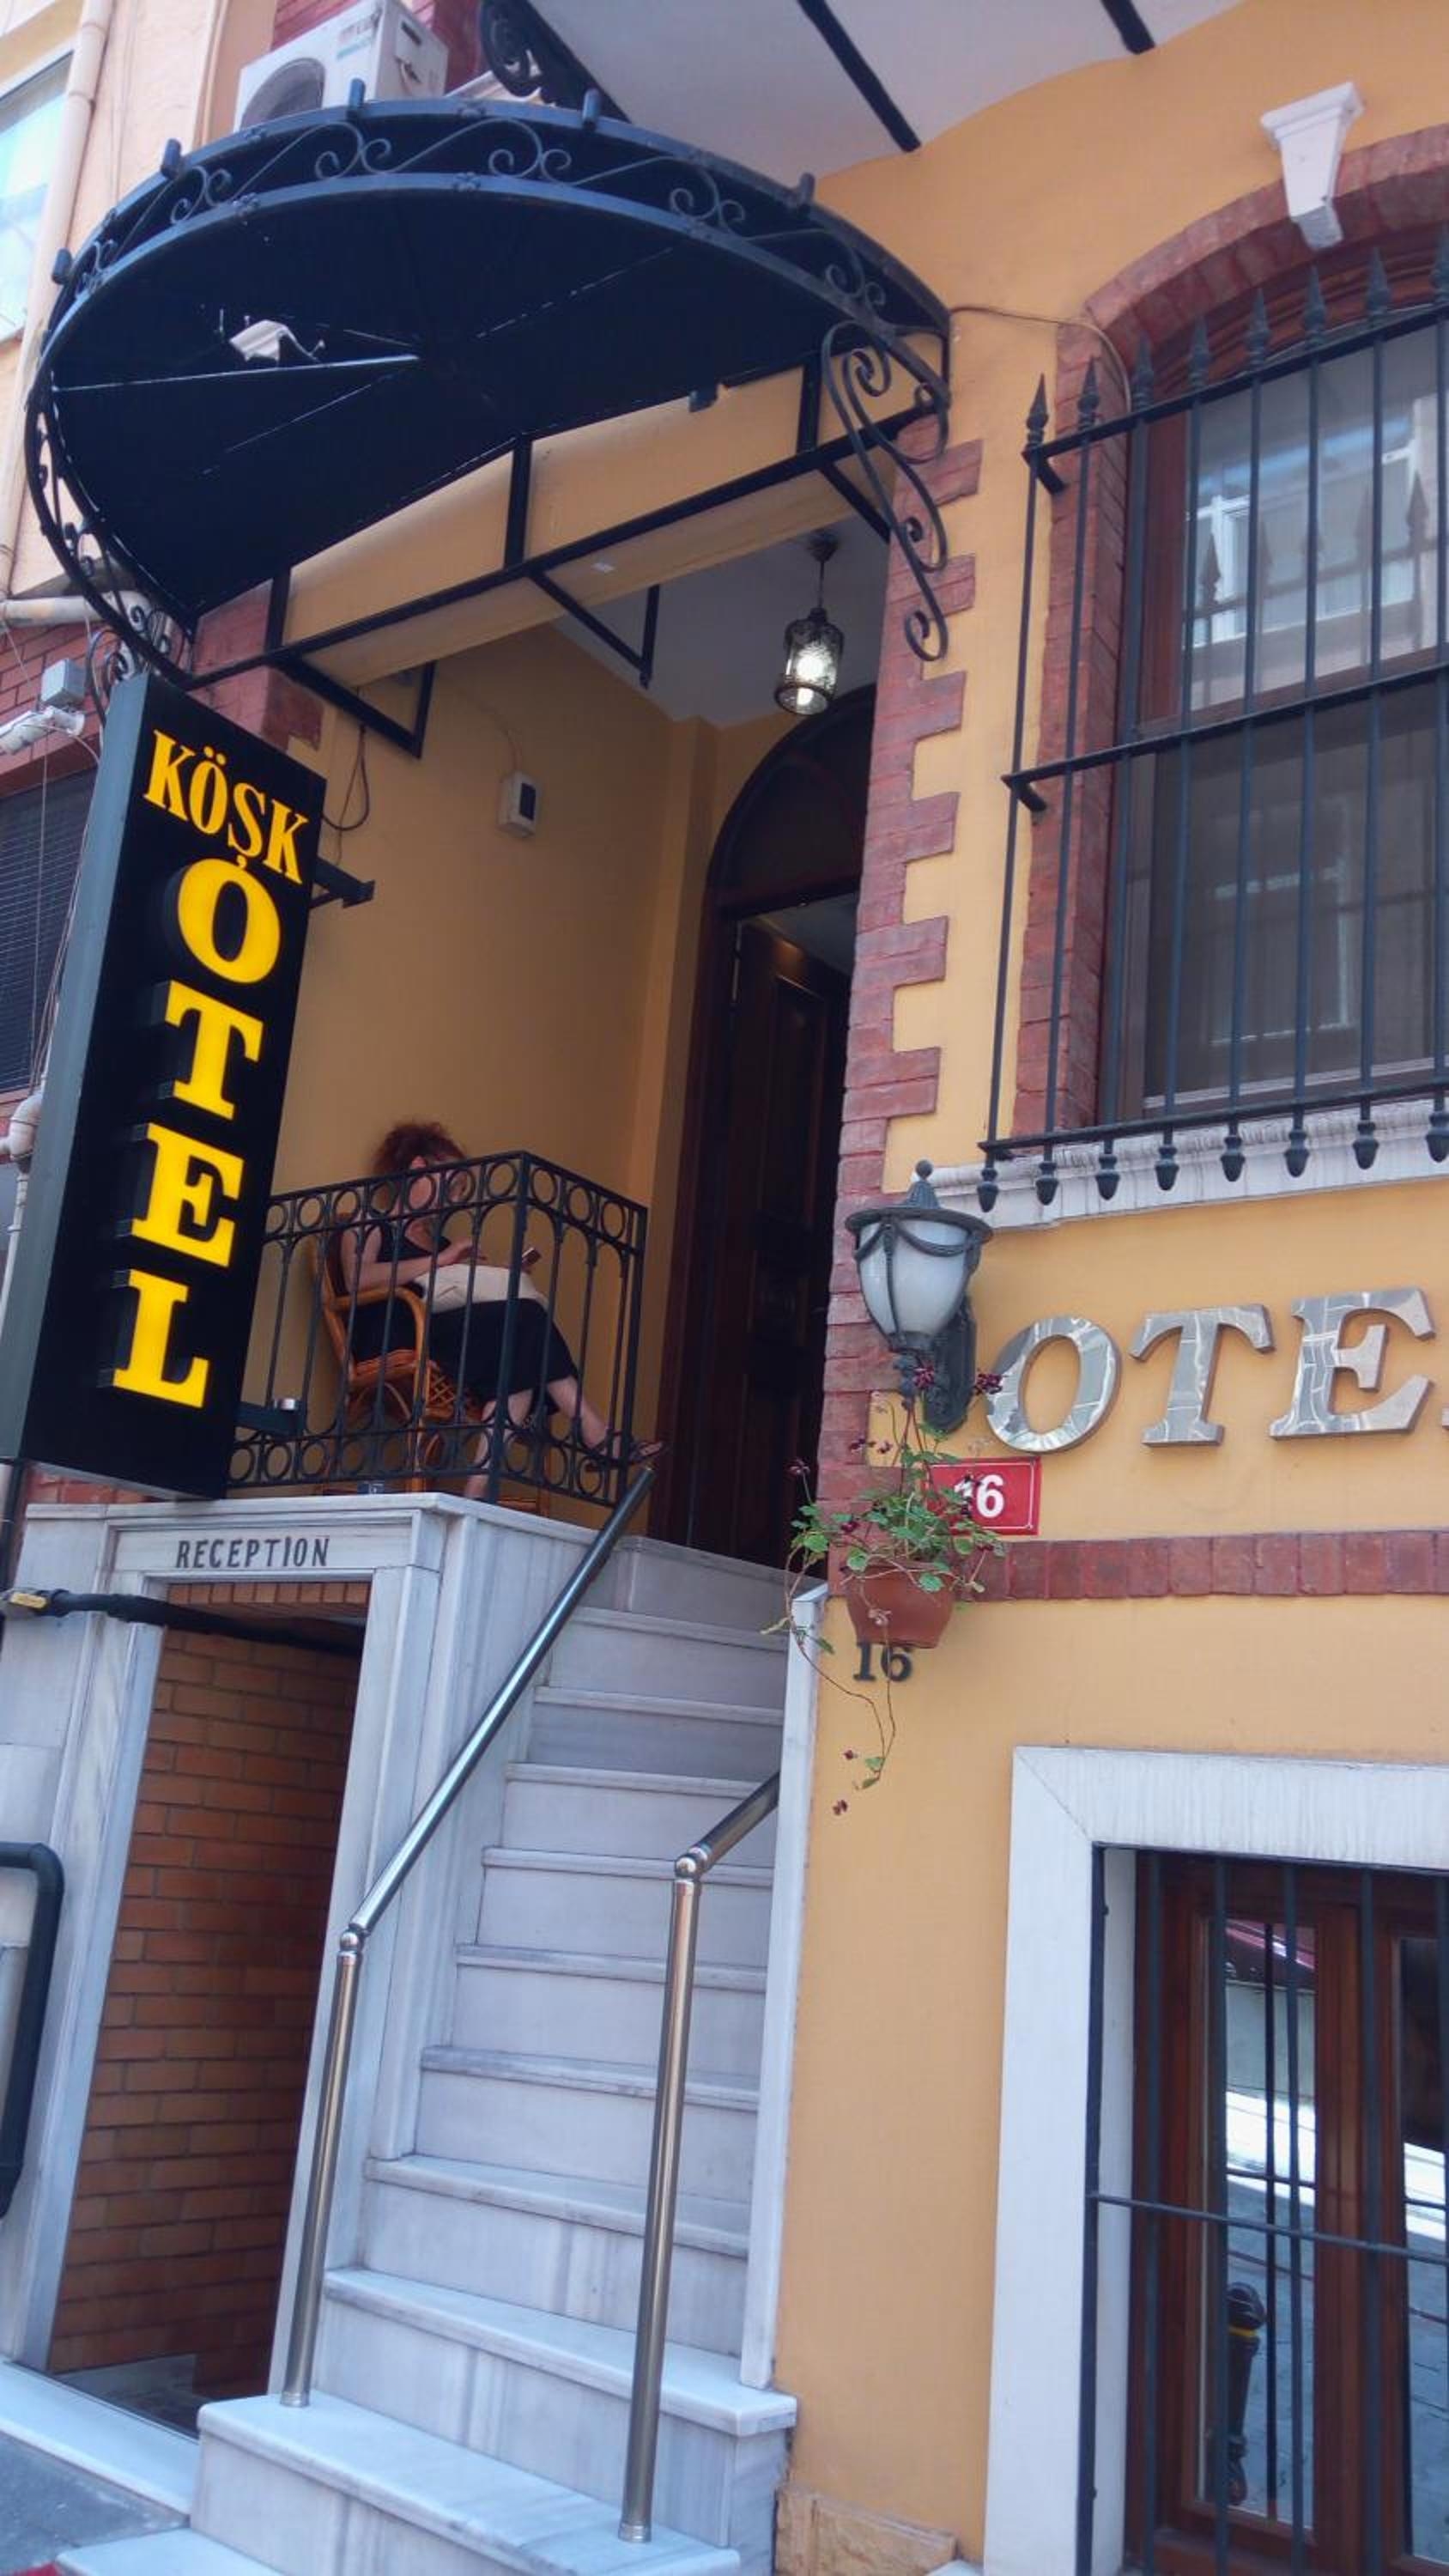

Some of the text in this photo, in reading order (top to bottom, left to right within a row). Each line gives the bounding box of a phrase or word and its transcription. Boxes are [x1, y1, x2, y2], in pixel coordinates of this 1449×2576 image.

[144, 730, 309, 884] KÖŞK
[112, 859, 281, 1408] OTEL
[986, 1287, 1449, 1455] OTE
[175, 1535, 330, 1569] RECEPTION
[853, 1640, 913, 1683] 16
